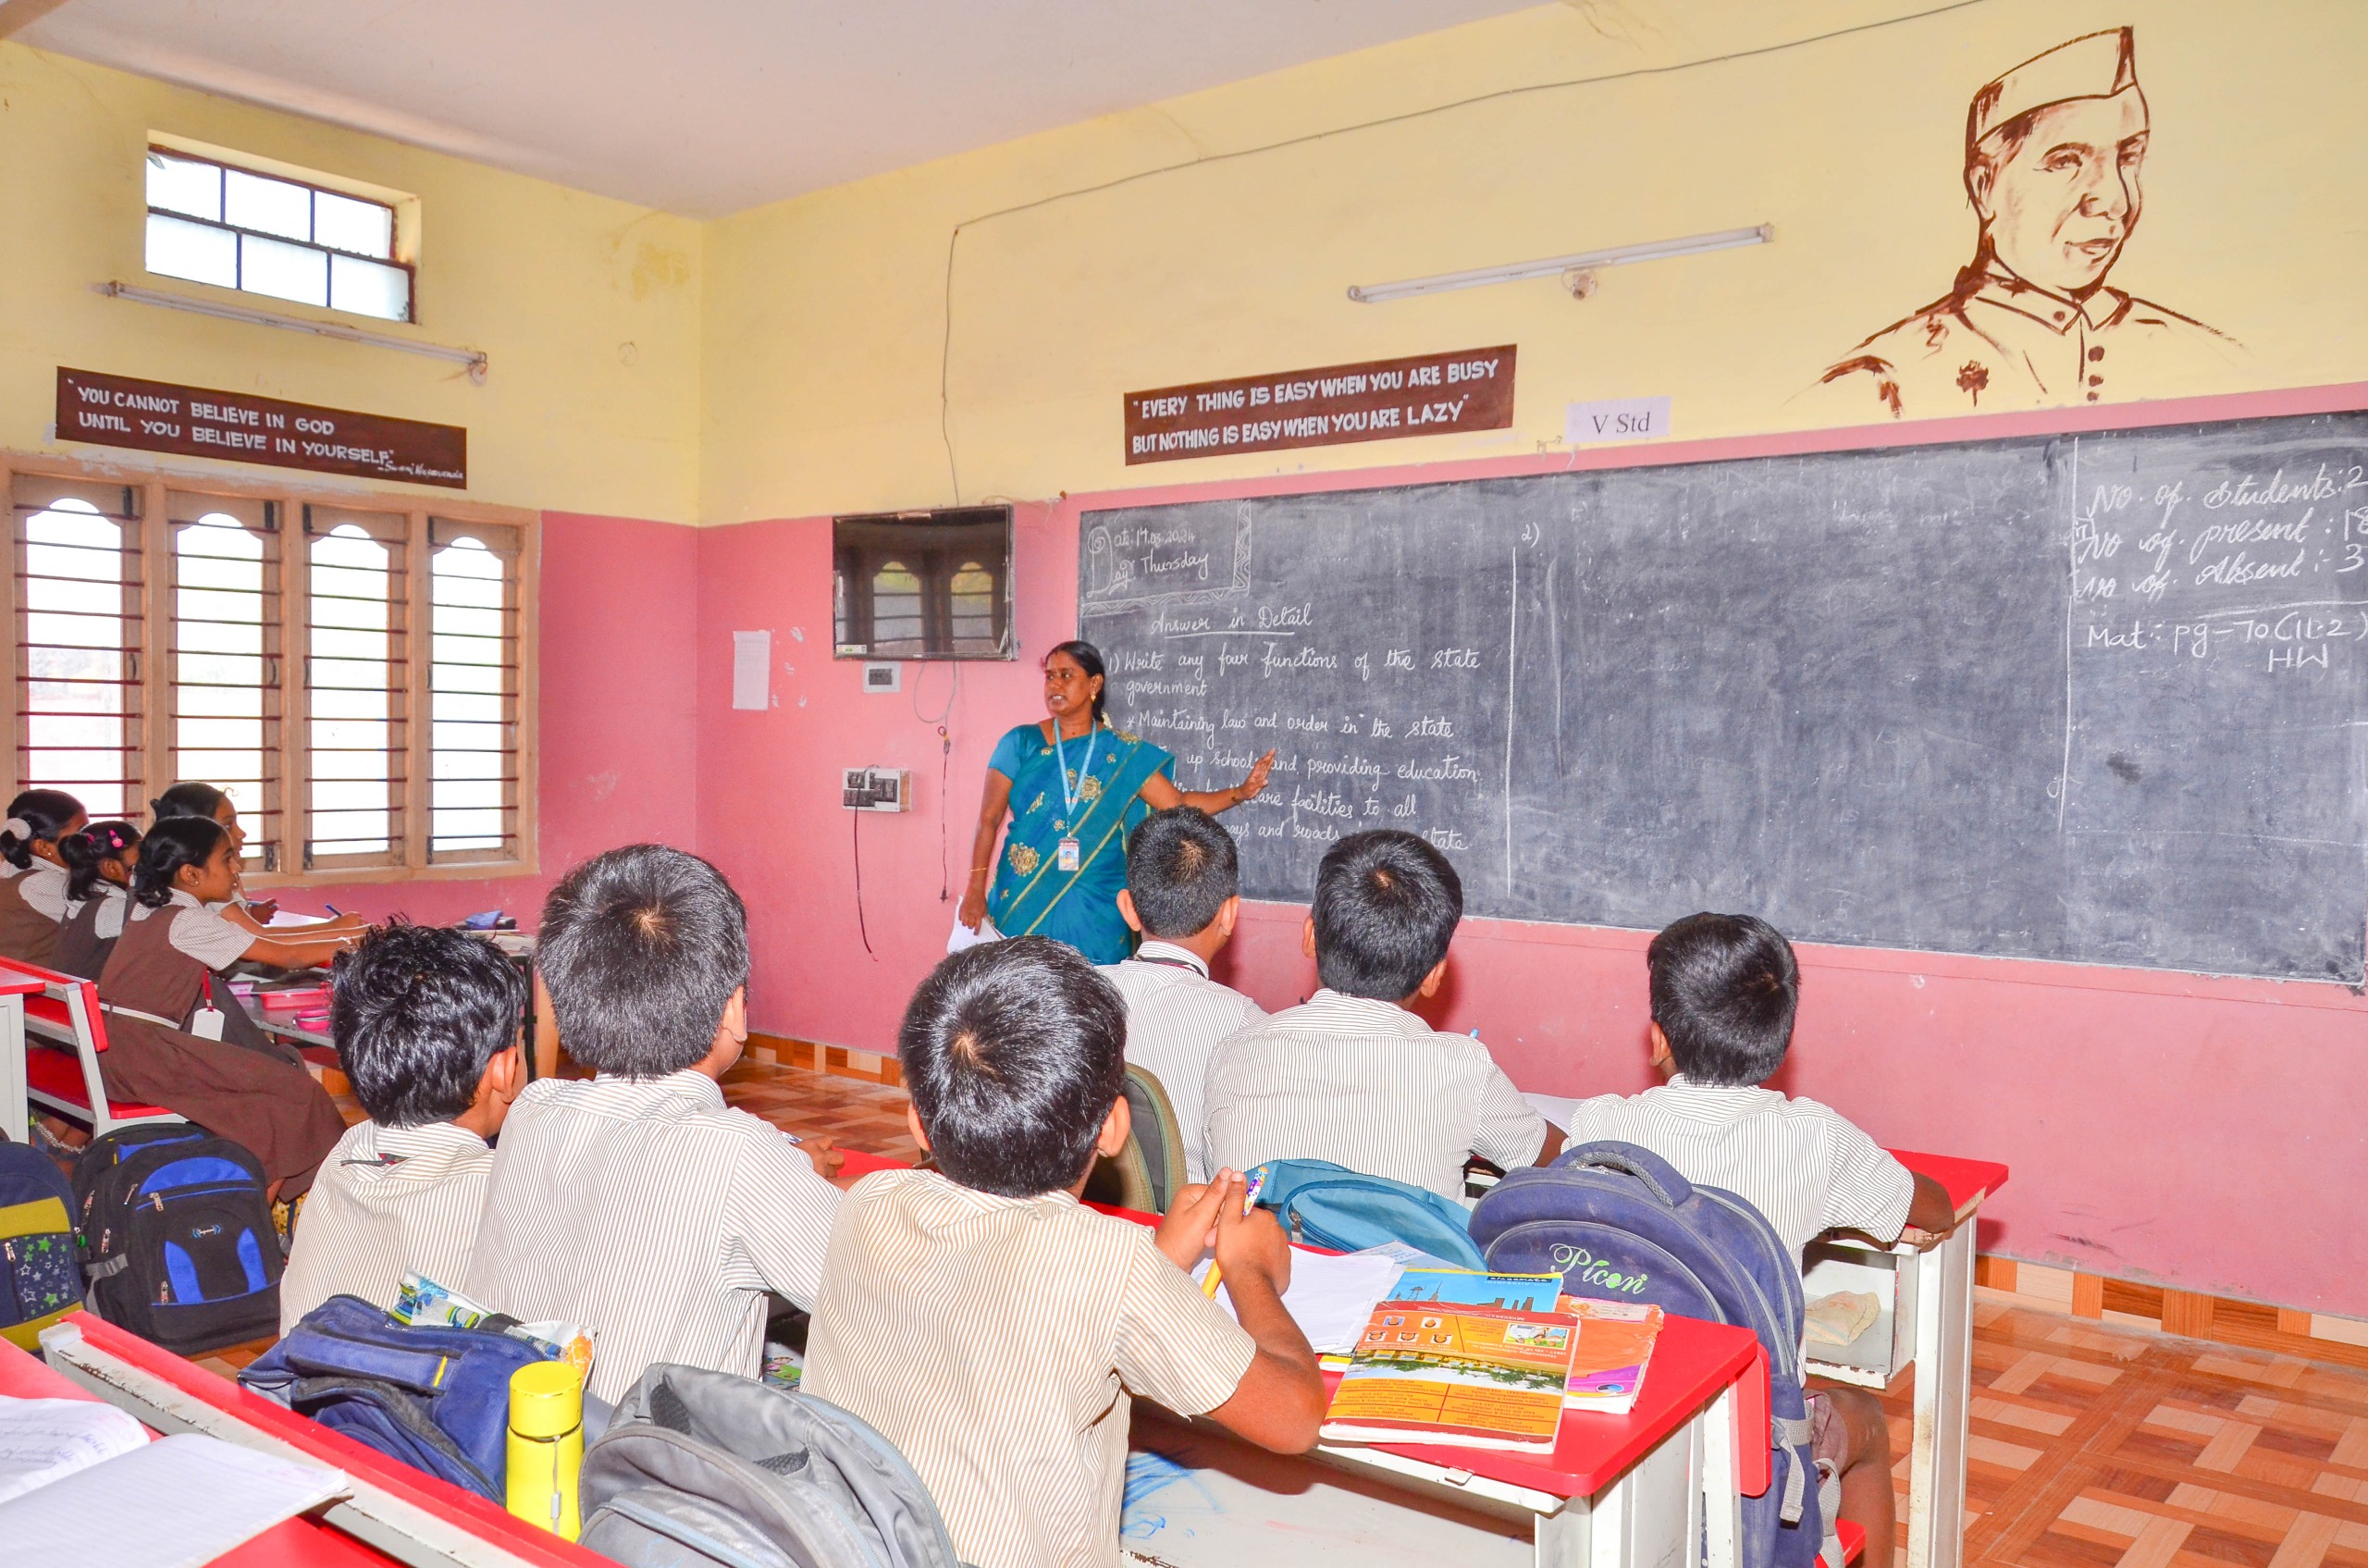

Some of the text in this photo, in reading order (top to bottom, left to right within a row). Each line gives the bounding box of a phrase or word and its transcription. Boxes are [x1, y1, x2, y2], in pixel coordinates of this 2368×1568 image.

[1196, 389, 1245, 412] THING
[1250, 387, 1270, 407] IS
[1275, 379, 1319, 404] EASY
[1320, 375, 1367, 398] WHEN
[1369, 370, 1403, 391] YOU
[1408, 365, 1441, 388] ARE
[1448, 359, 1498, 384] BUSY
[79, 412, 131, 432] UNTIL
[140, 419, 180, 438] YOU
[191, 426, 266, 450] BELIEVE
[276, 438, 296, 453] IN
[114, 392, 179, 414] CANNOT
[191, 401, 259, 426] BELIEVE
[265, 413, 285, 429] IN
[295, 417, 335, 436] GOD
[1132, 434, 1156, 454] BUT
[1158, 427, 1219, 451] NOTHING
[1223, 425, 1240, 444] IS
[1242, 420, 1282, 443] EASY
[1283, 415, 1329, 438] WHEN
[1331, 411, 1368, 432] YOU
[1370, 407, 1400, 429] ARE
[1592, 412, 1650, 434] V Std
[1522, 522, 1540, 549] 2)
[1141, 549, 1209, 580] Thursday
[2336, 543, 2366, 573] 3
[1151, 602, 1313, 635] Answer in Detail
[1124, 650, 1164, 671] Write
[1178, 653, 1202, 680] any
[1218, 642, 1249, 676] four
[1261, 640, 1338, 678] functions
[1355, 652, 1370, 681] of
[1384, 649, 1415, 670] the
[1127, 679, 1207, 707] government
[1139, 709, 1215, 749] Maintaining
[1221, 709, 1246, 728] law
[1254, 712, 1277, 728] and
[1287, 714, 1328, 732] order
[1340, 716, 1359, 735] in
[1371, 718, 1393, 737] the
[1187, 754, 1202, 772] up
[1308, 755, 1390, 791] providing
[1291, 784, 1353, 821] facilities
[1363, 796, 1379, 815] to
[1394, 794, 1416, 817] all
[1258, 821, 1286, 838] and
